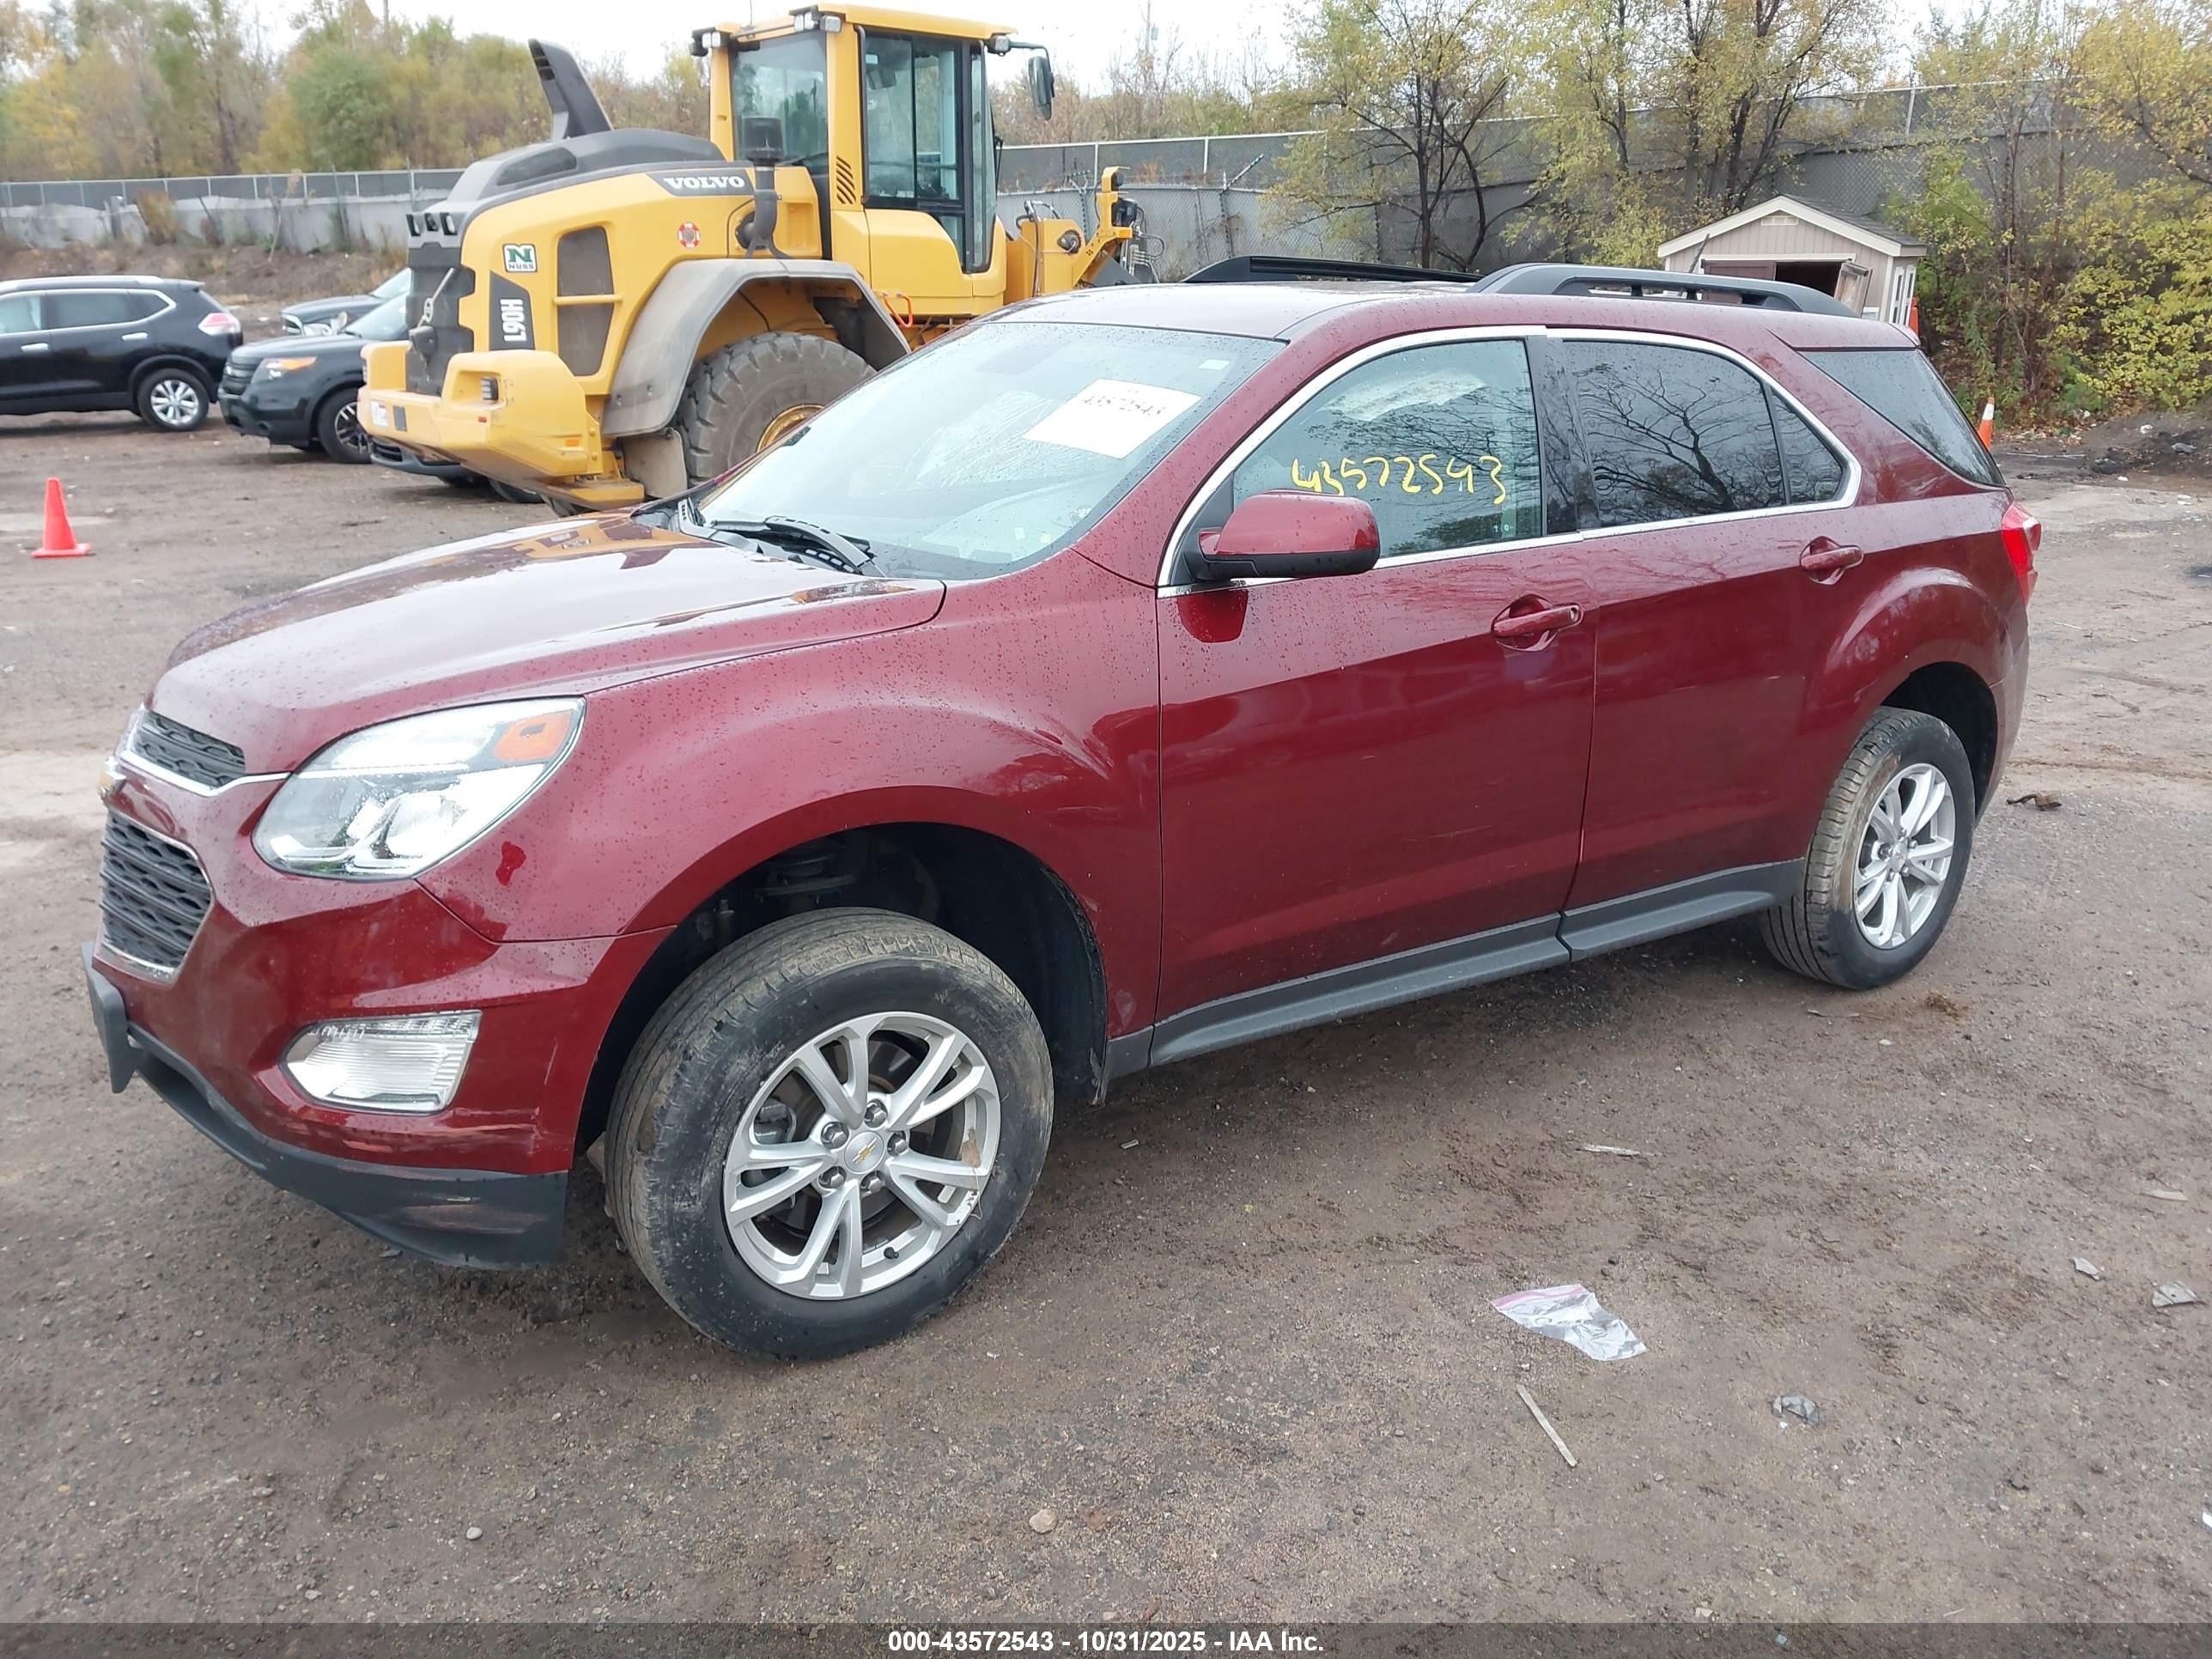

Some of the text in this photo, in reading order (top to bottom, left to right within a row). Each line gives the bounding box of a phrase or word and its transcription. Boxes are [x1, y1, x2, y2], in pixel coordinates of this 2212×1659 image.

[663, 176, 745, 189] VOLVO
[507, 247, 533, 263] N
[500, 299, 527, 342] L90H
[1291, 453, 1507, 505] 43572543
